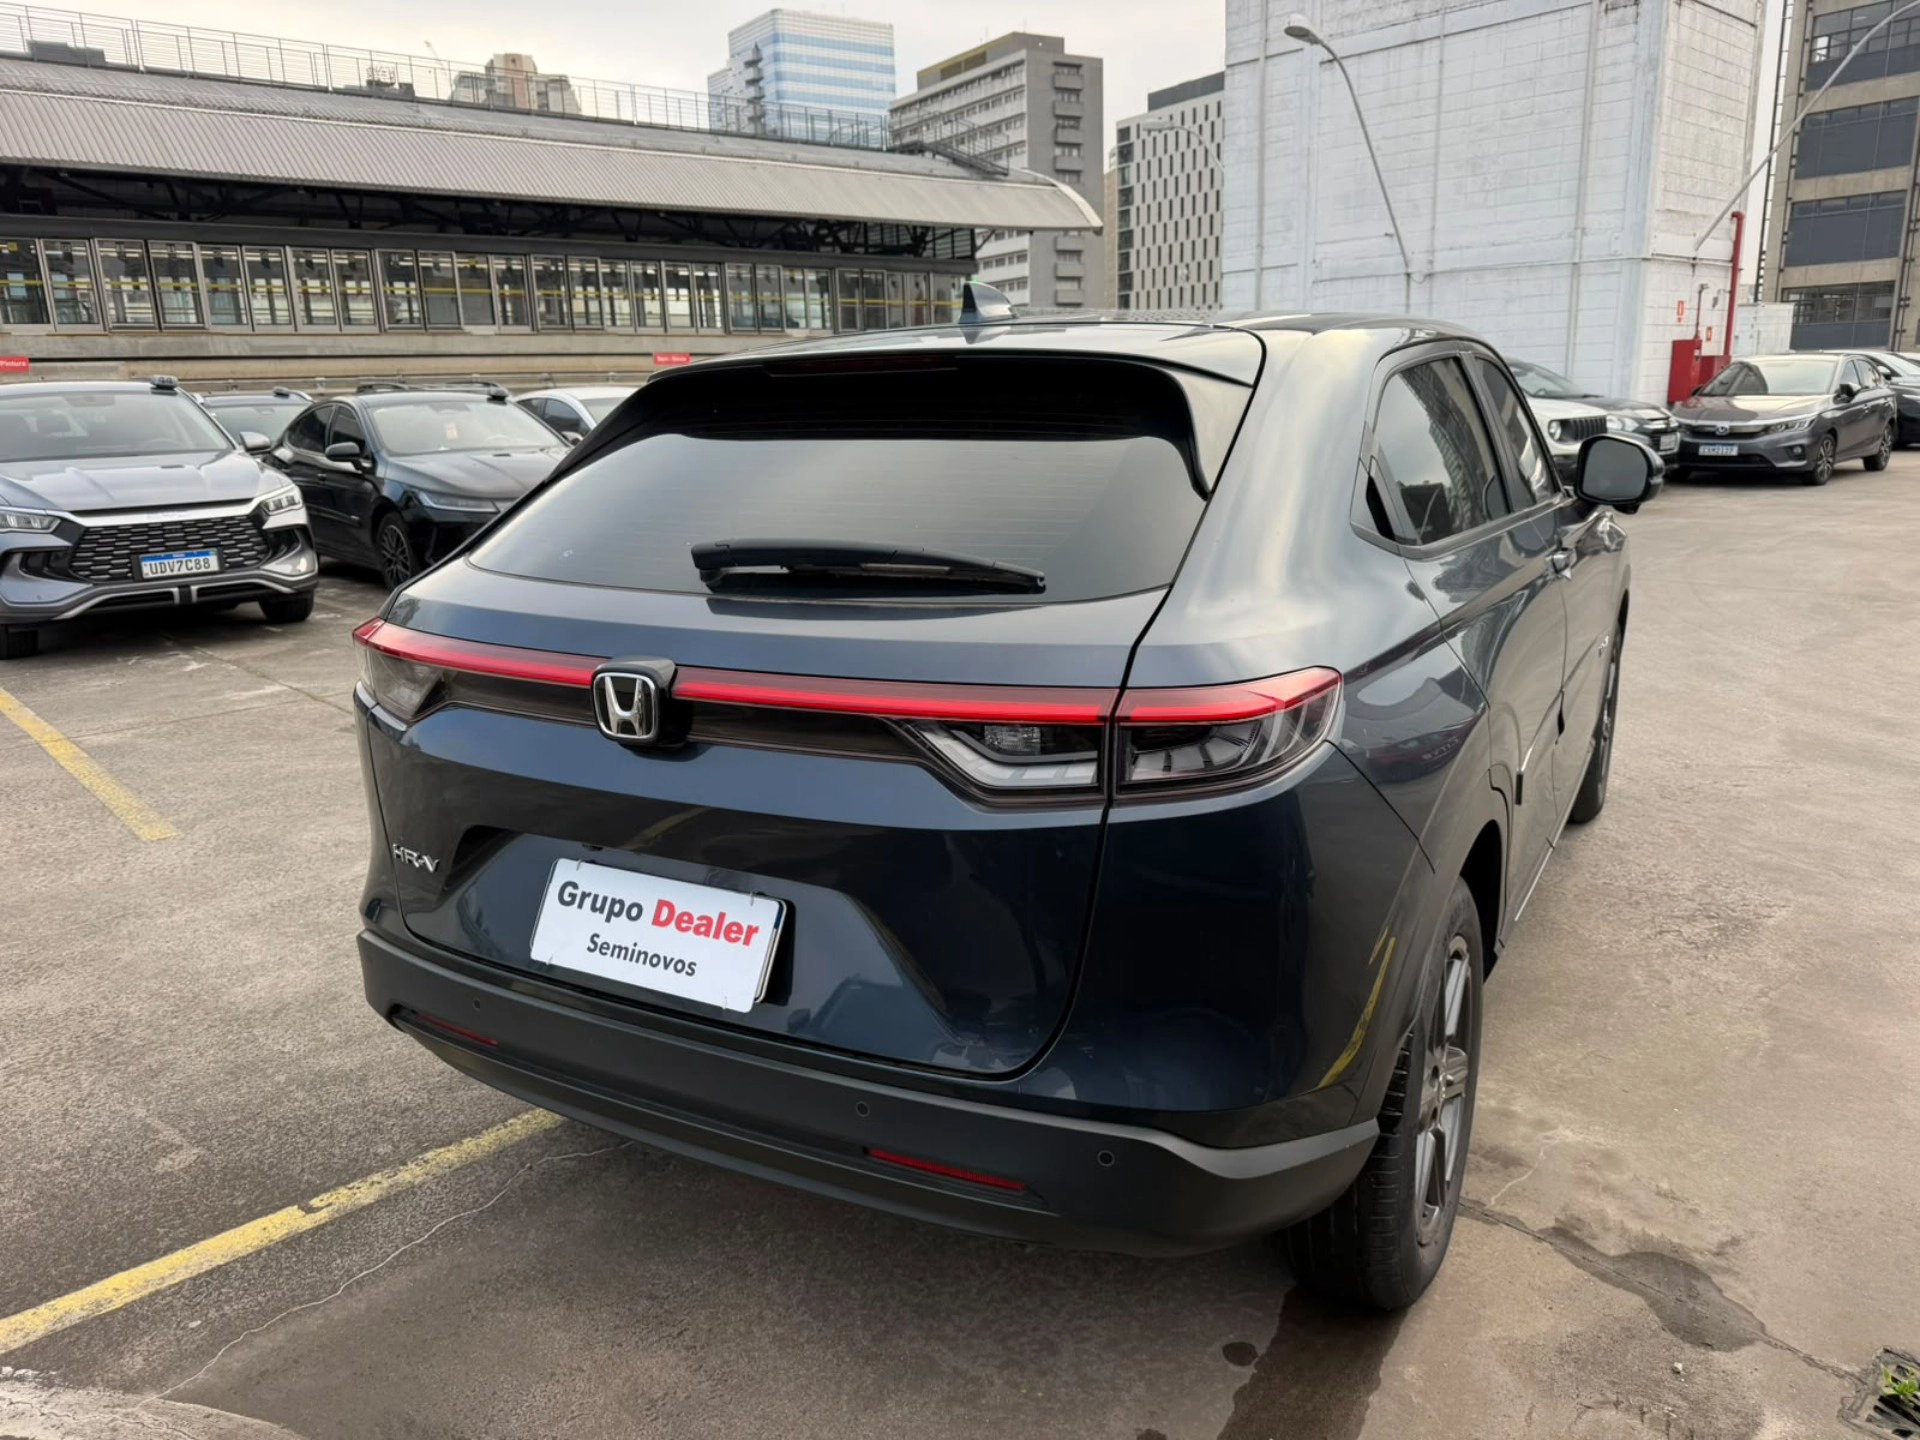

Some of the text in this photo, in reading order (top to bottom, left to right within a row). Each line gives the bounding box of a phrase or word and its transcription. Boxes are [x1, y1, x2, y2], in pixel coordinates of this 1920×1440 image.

[148, 557, 211, 576] UDV7C88
[392, 843, 440, 873] HR-V
[557, 880, 760, 947] Grupo Dealer
[586, 932, 698, 978] Seminovos
